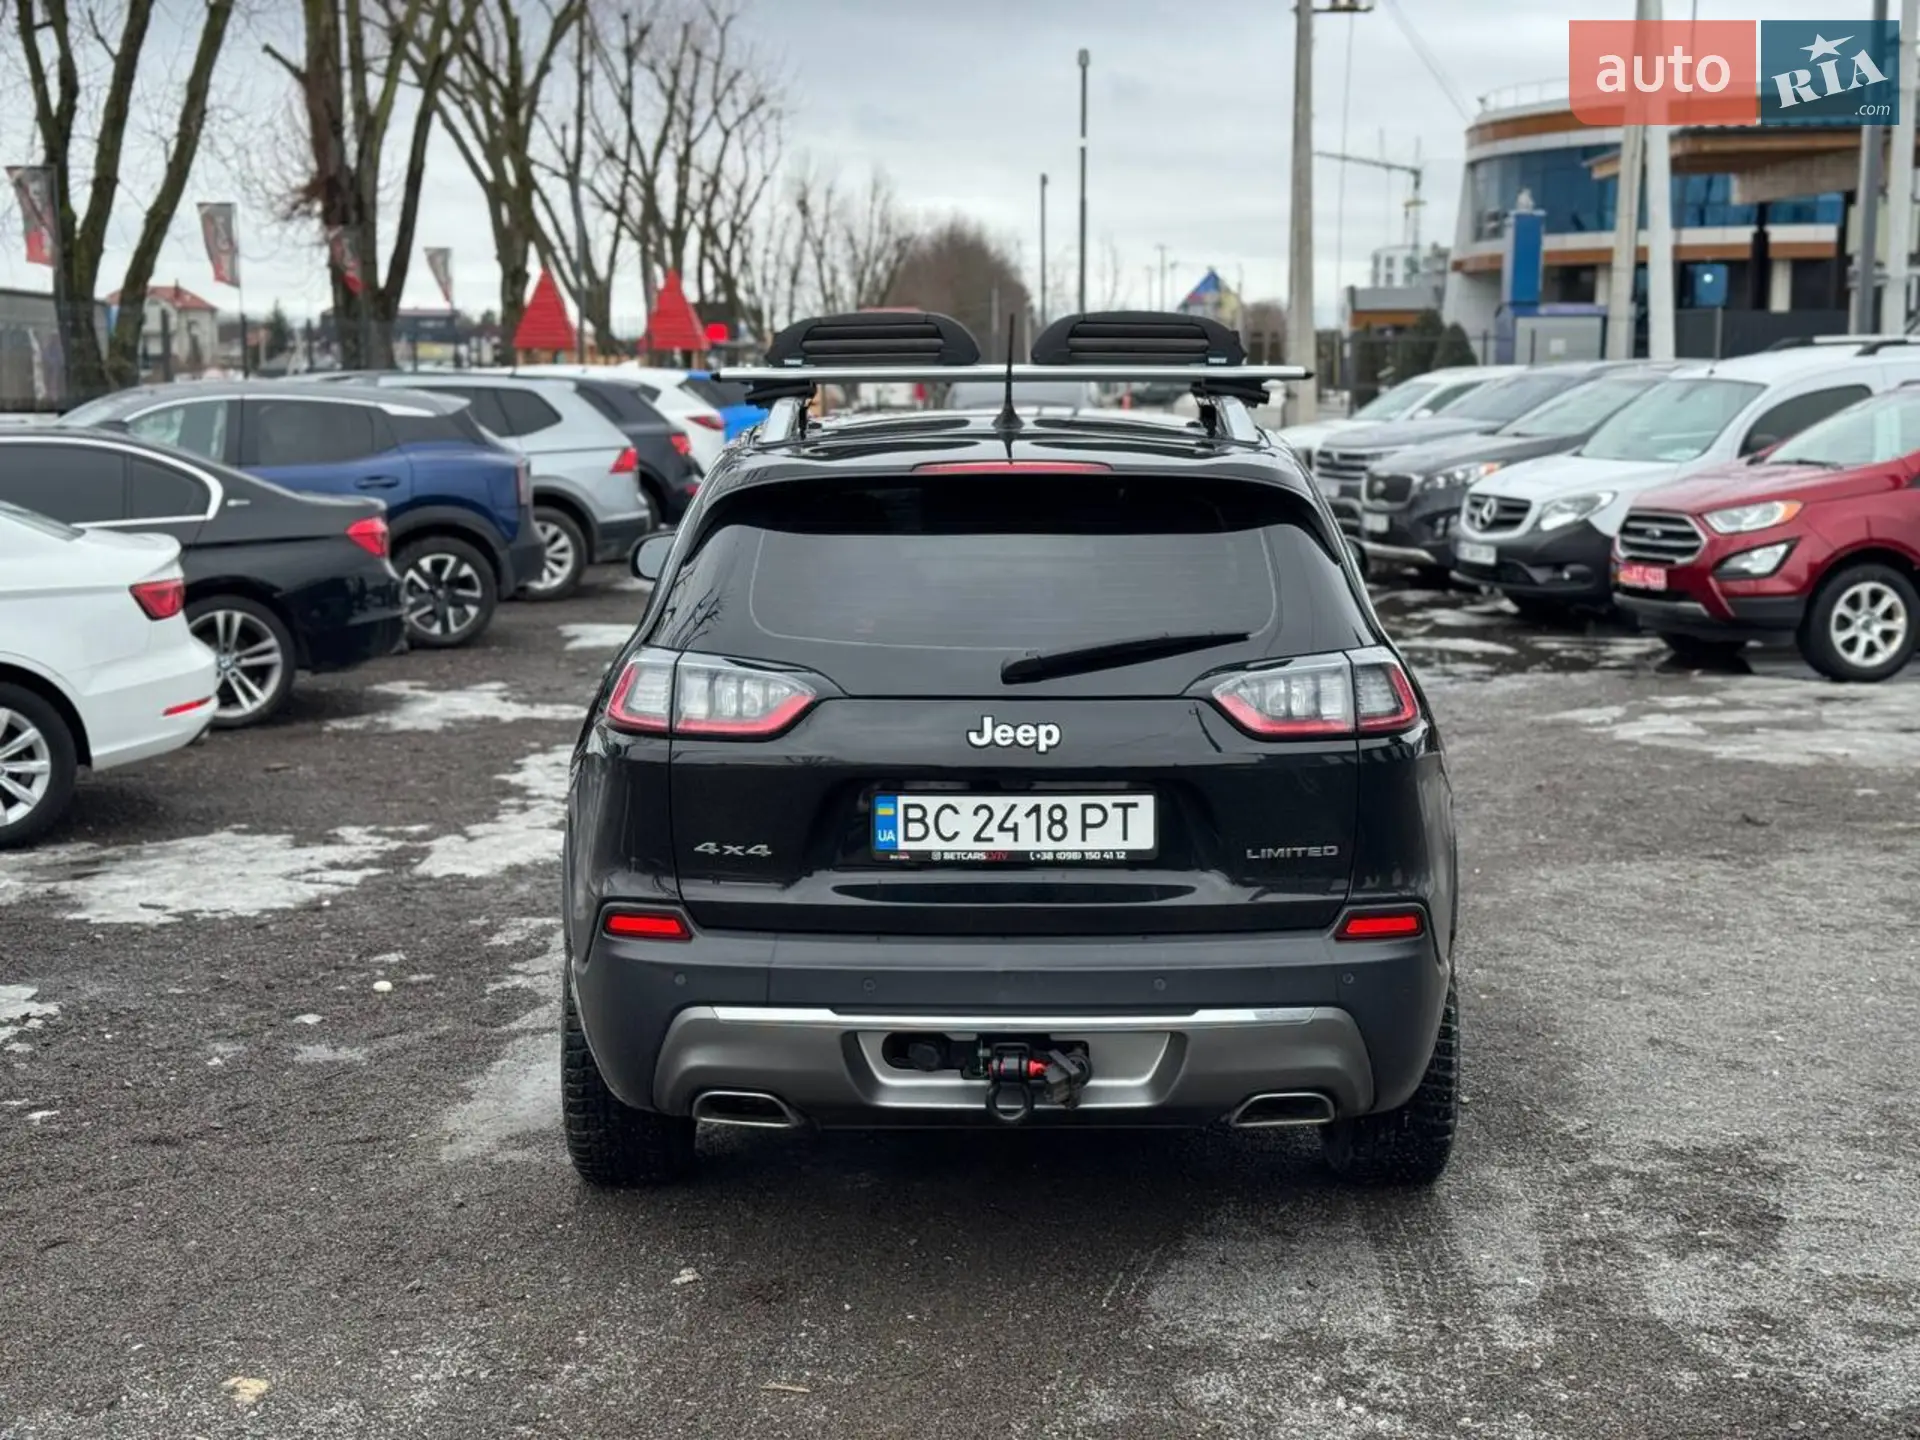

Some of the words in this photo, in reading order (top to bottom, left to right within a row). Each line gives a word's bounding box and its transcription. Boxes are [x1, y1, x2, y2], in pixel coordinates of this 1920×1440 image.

[967, 715, 1062, 754] Jeep
[902, 802, 960, 843] BC
[972, 802, 1068, 843] 2418
[1081, 801, 1139, 843] PT
[878, 830, 896, 842] UA
[1246, 845, 1339, 859] LIMITED
